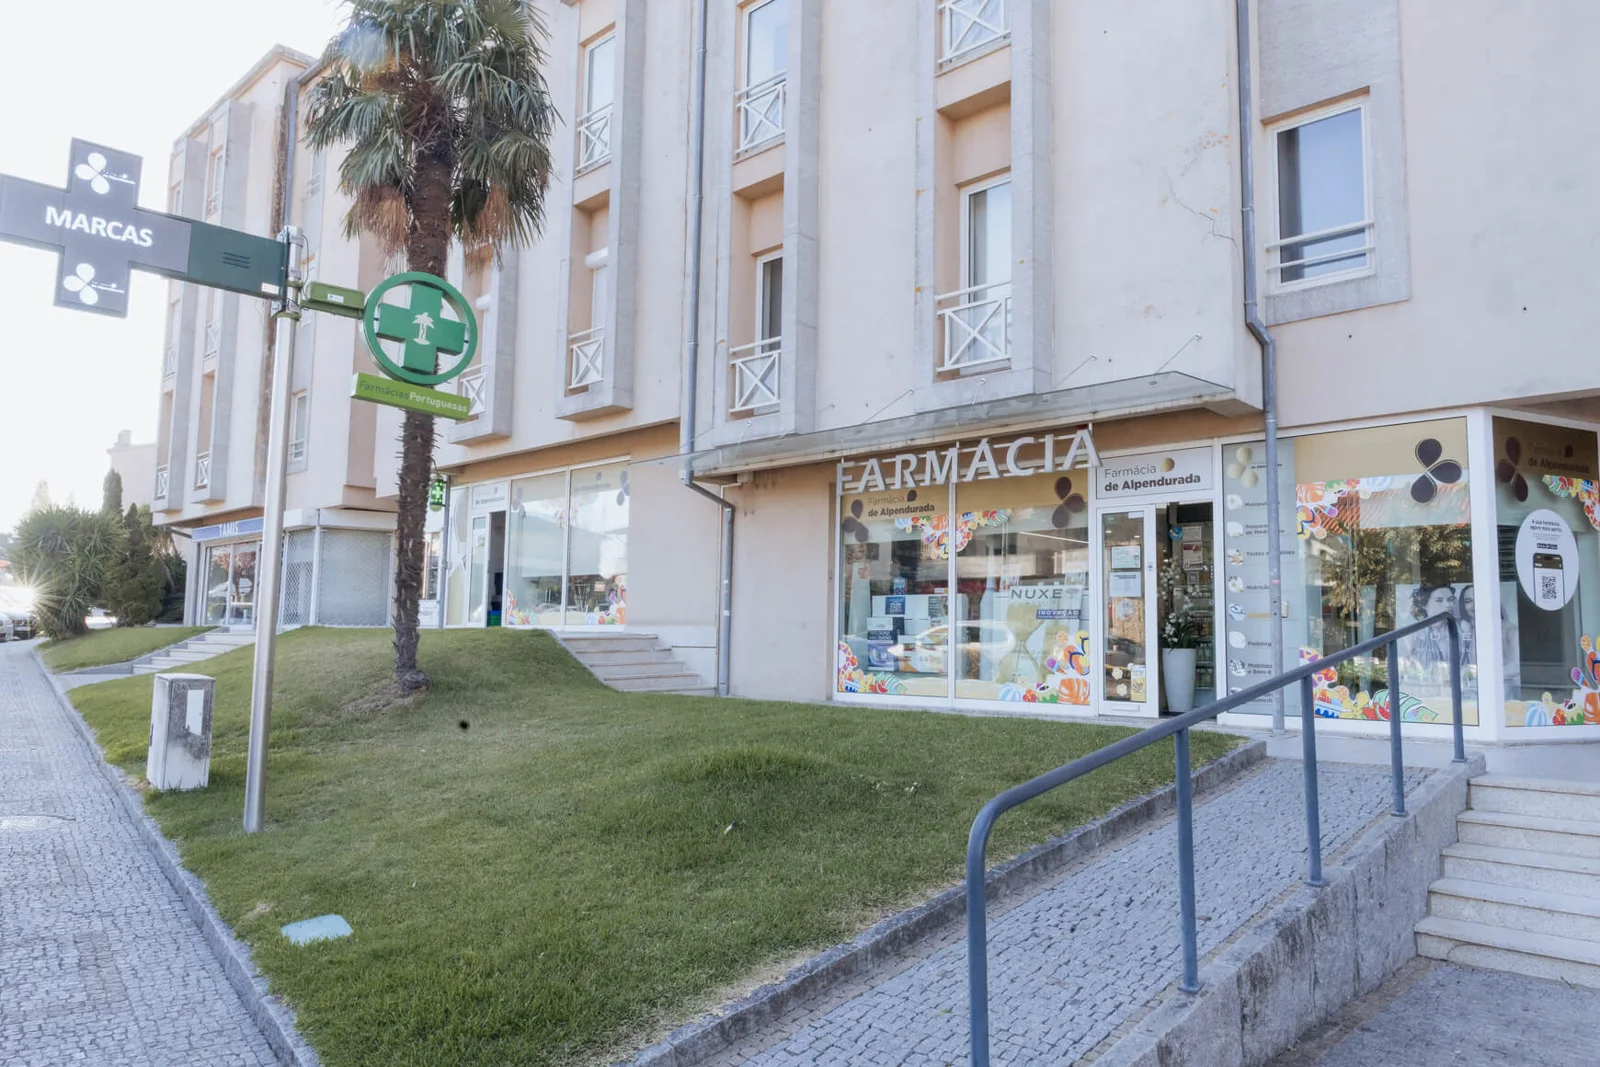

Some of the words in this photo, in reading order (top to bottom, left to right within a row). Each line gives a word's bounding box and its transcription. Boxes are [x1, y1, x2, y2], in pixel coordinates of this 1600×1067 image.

[45, 205, 153, 247] MARCAS
[409, 391, 468, 413] Portuguesas
[836, 429, 1102, 496] FARMÁCIA
[1104, 465, 1157, 478] Farmácia
[1104, 482, 1119, 492] de
[1122, 473, 1201, 491] Alpendurada
[868, 494, 905, 506] Farmácia
[868, 508, 879, 517] de
[880, 503, 935, 517] Alpendurada
[1011, 588, 1064, 599] NUXE
